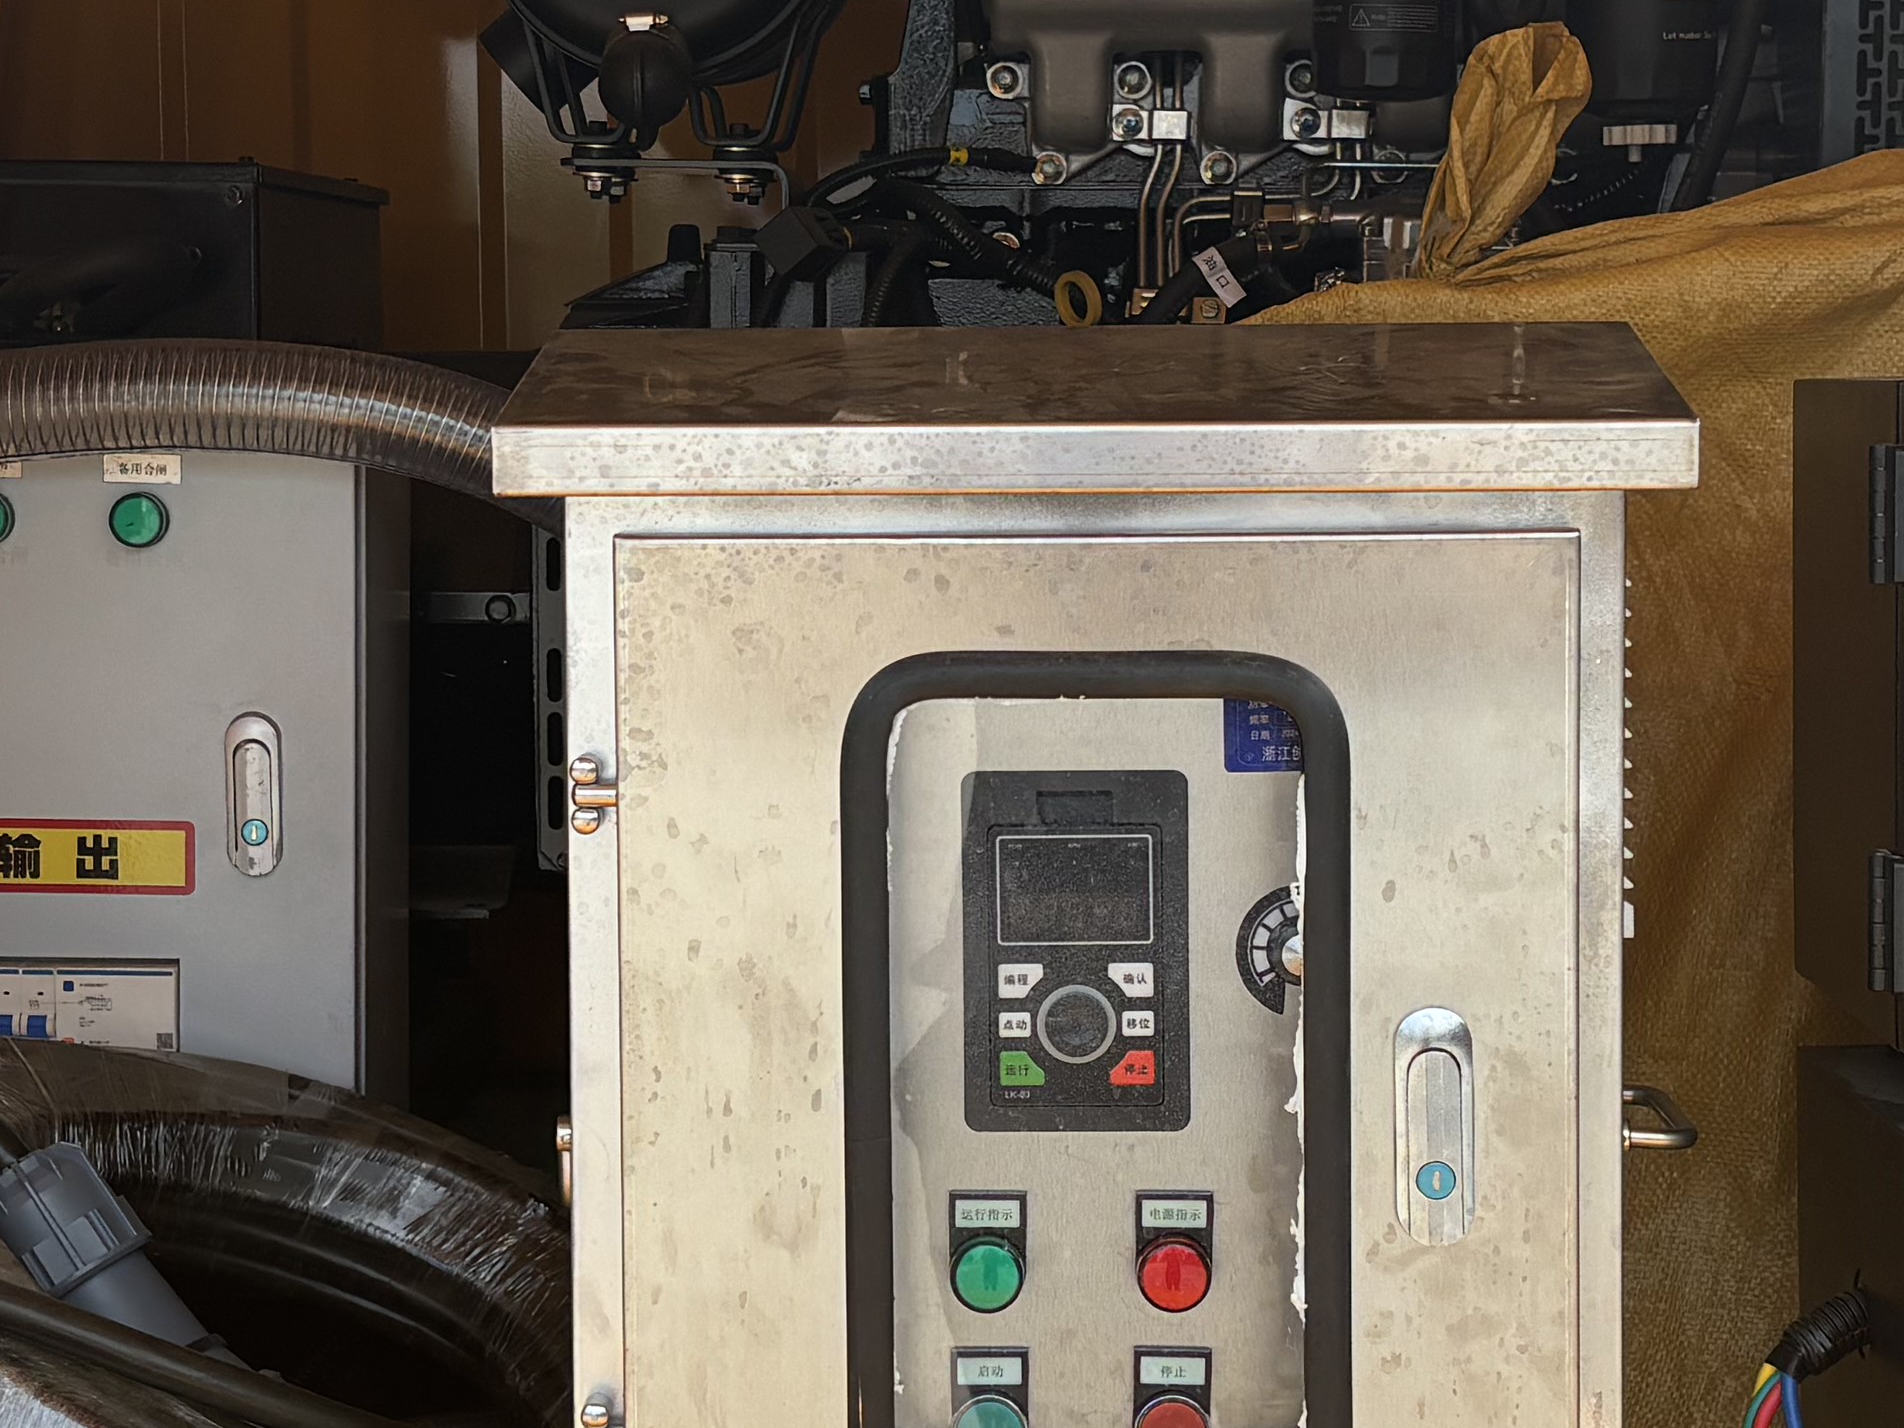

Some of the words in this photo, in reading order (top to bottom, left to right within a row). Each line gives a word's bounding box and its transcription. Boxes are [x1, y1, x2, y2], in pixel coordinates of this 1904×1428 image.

[1004, 973, 1029, 986] 编程
[1123, 973, 1148, 985] 确认
[1003, 1019, 1028, 1031] 点动
[1126, 1018, 1151, 1030] 移位
[1004, 1064, 1029, 1077] 运行
[1124, 1064, 1149, 1076] 停止
[960, 1208, 1014, 1222] 运行指示
[1149, 1208, 1203, 1222] 电源指示
[977, 1364, 1004, 1379] 启动
[1160, 1365, 1187, 1379] 停止
